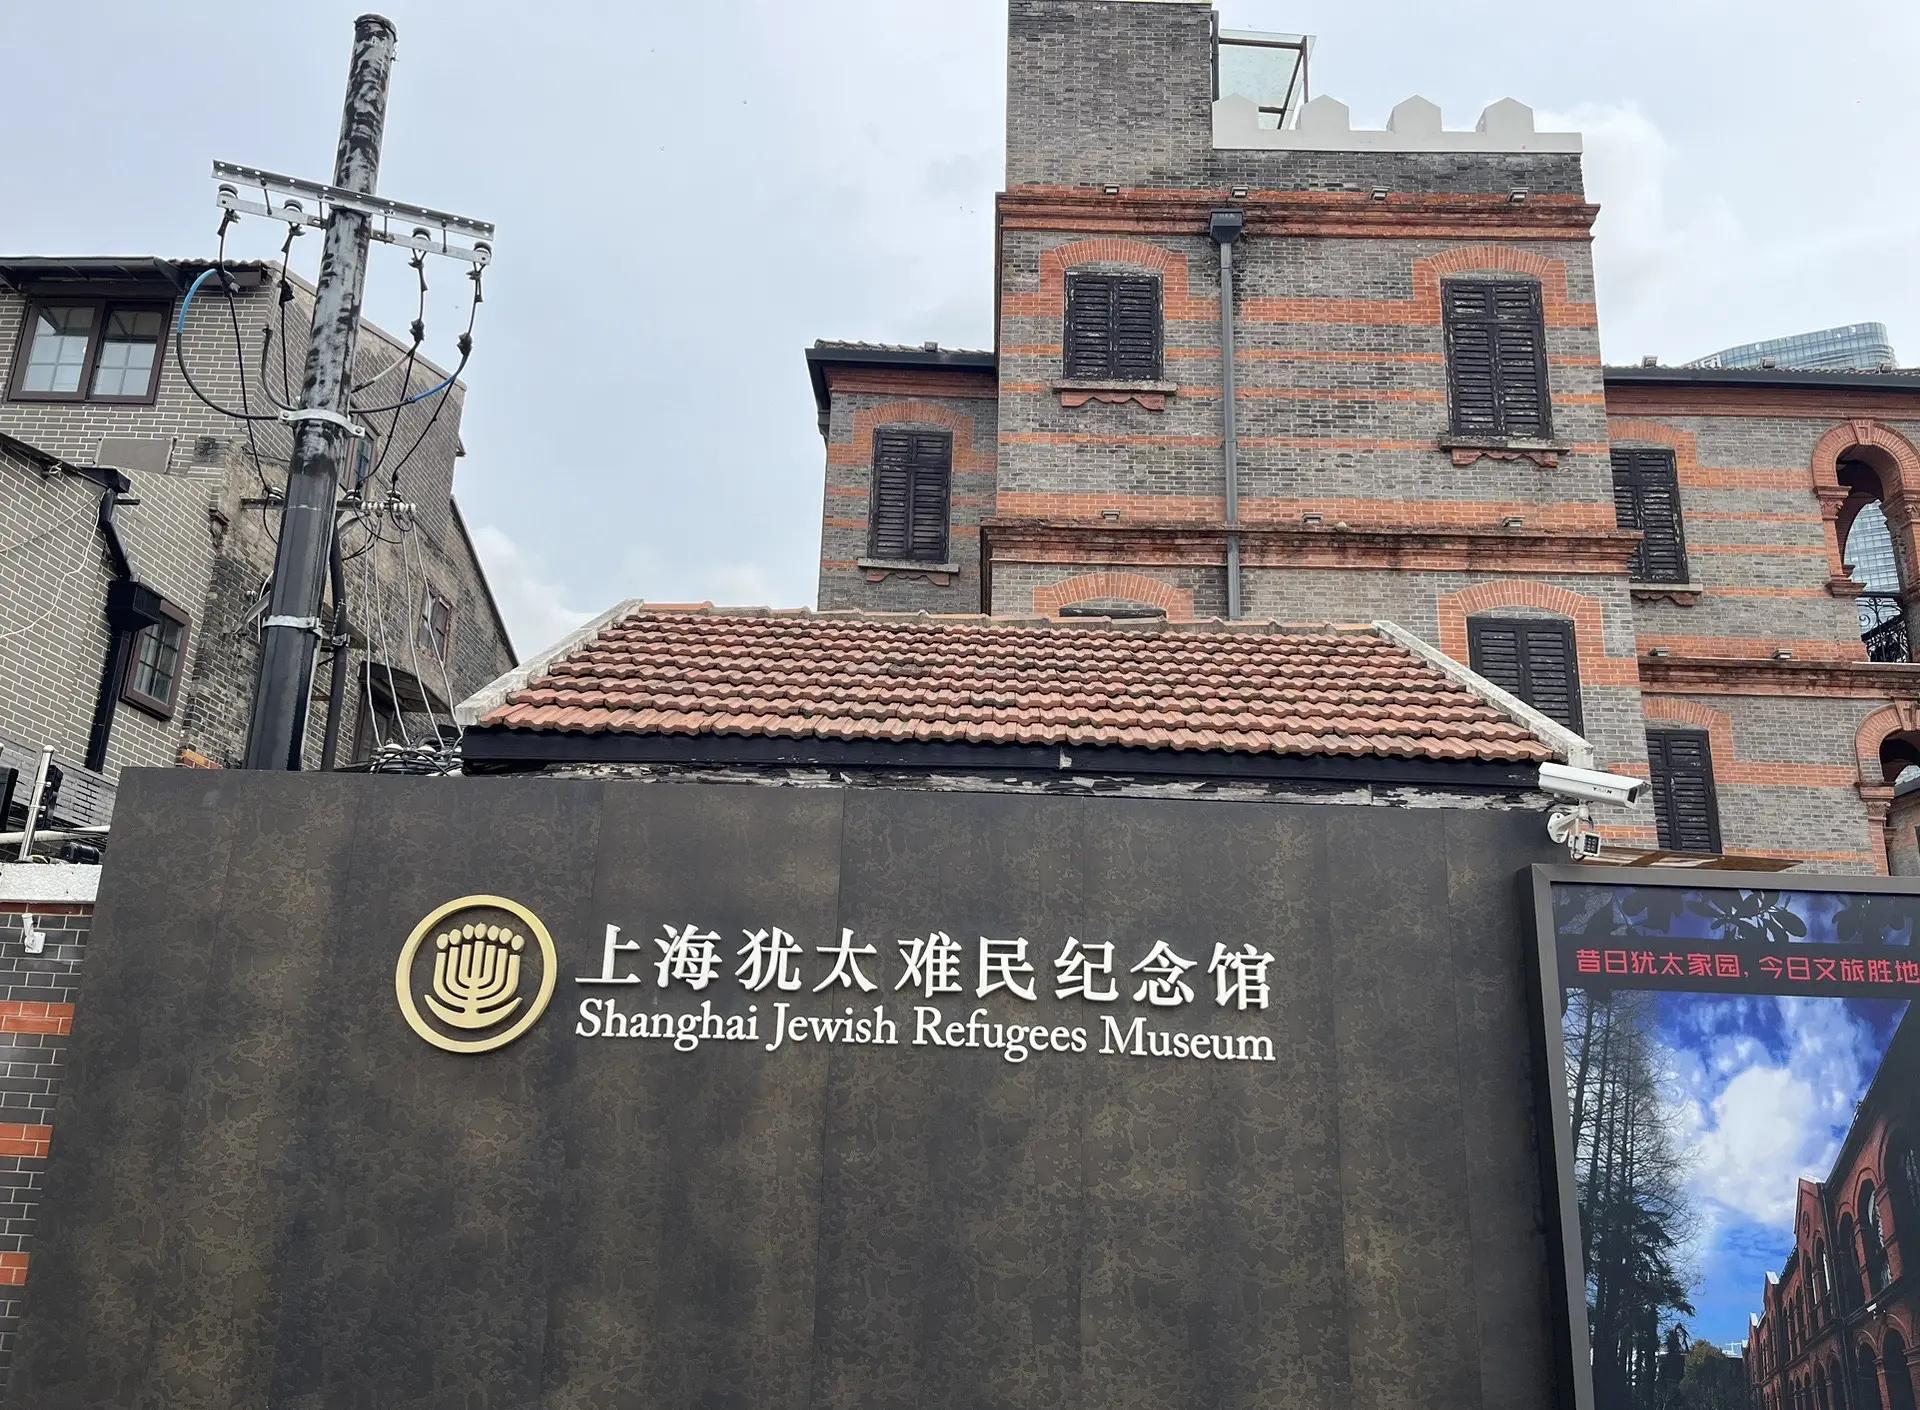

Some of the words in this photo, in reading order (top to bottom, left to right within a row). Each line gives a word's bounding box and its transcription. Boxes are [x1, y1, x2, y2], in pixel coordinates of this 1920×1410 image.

[574, 923, 1276, 1011] 上海犹太难民纪念馆
[575, 998, 760, 1052] Shanghai
[765, 1002, 899, 1051] Jewish
[911, 1005, 1088, 1063] Refugees
[1098, 1014, 1276, 1062] Museum
